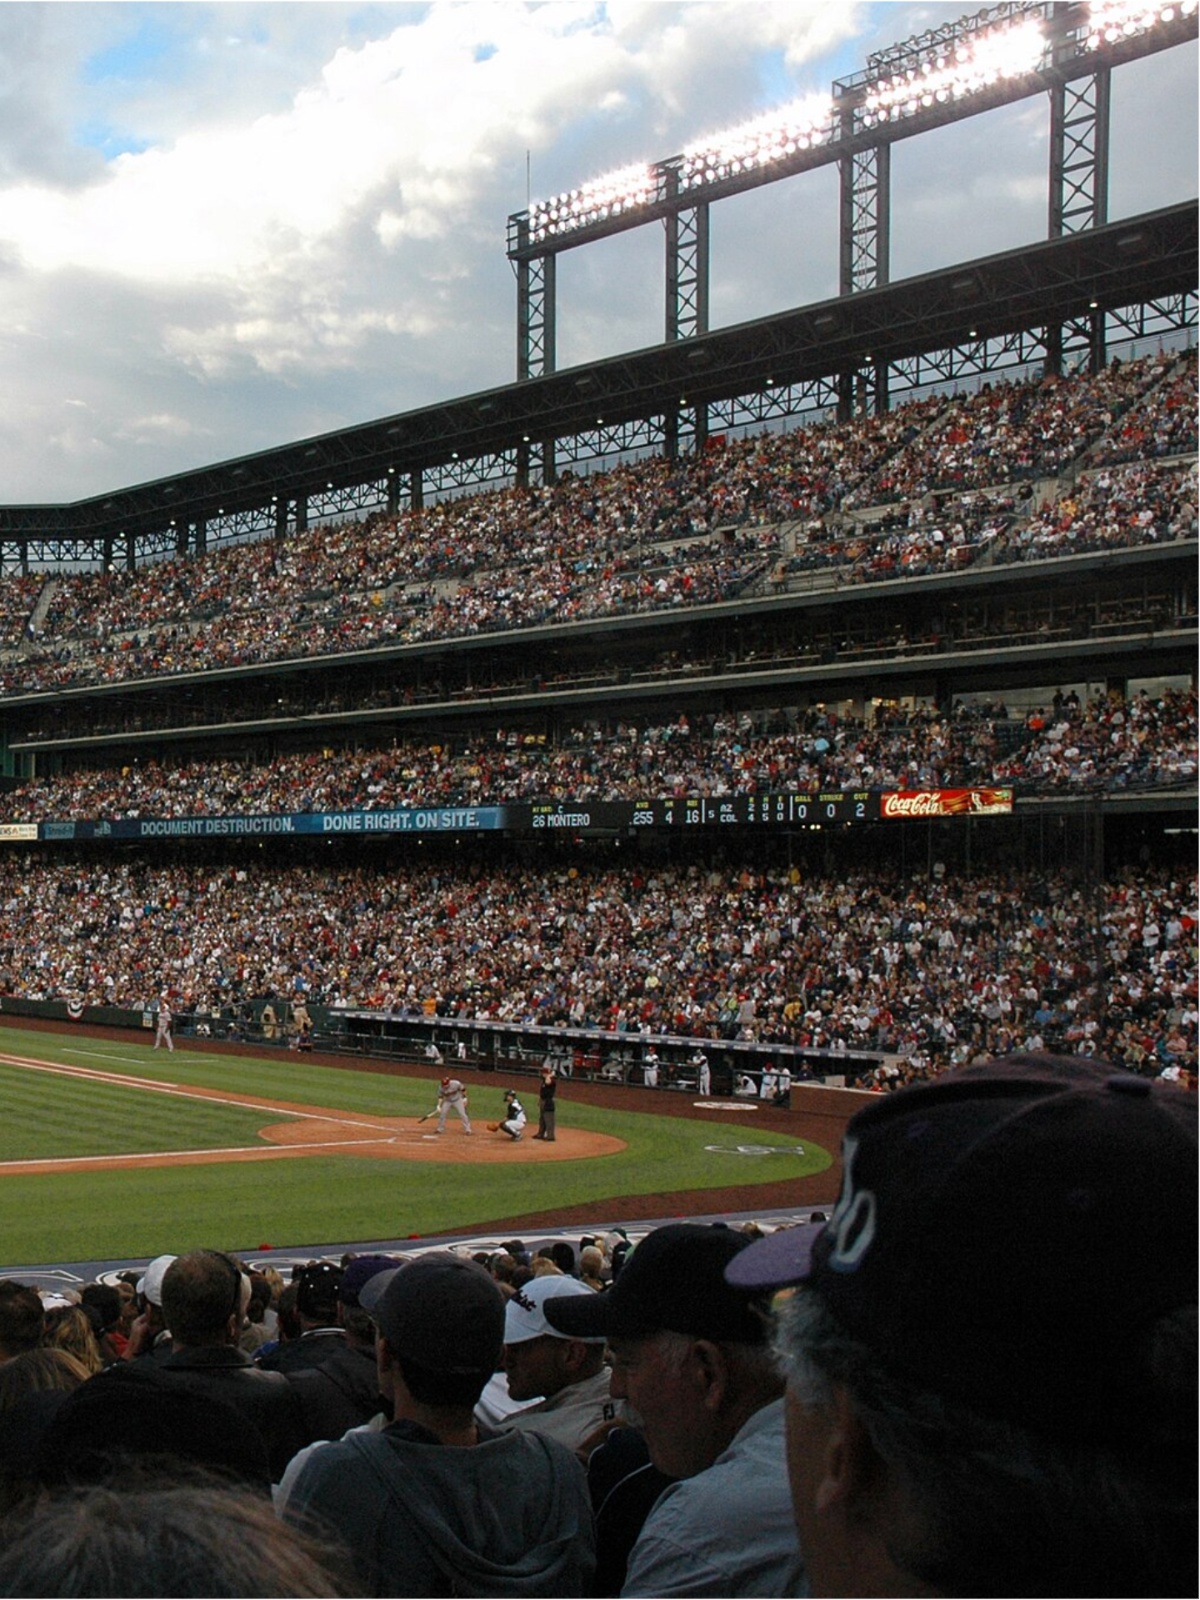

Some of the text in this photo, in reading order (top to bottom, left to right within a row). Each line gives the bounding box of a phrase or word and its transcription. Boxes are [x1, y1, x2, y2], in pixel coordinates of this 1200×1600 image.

[558, 805, 564, 814] C
[708, 810, 715, 818] 5
[748, 803, 755, 812] 2
[777, 802, 784, 811] 0
[798, 803, 865, 818] 0 0 2
[323, 811, 480, 831] DONE RIGHT. ON SITE.
[532, 813, 590, 827] 26 MONTERO
[665, 810, 673, 824] 4
[686, 810, 699, 824] 16
[720, 814, 738, 822] COL
[141, 816, 295, 835] DOCUMENT DESTRUCTION.
[603, 1404, 615, 1420] FJ
